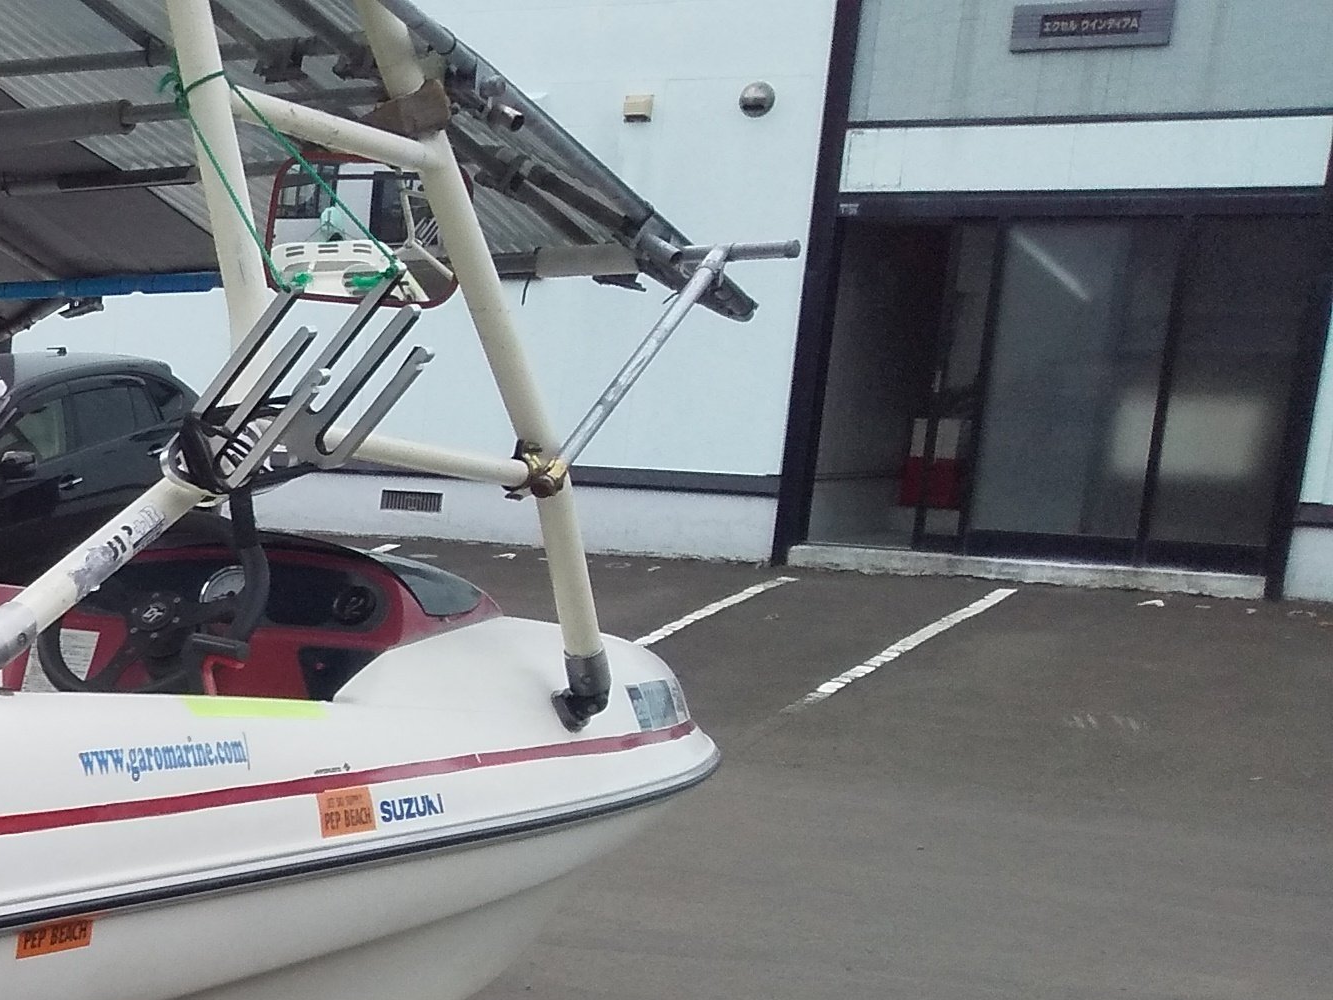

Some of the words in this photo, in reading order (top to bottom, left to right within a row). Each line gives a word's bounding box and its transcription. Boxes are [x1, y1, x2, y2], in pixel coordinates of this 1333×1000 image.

[1043, 20, 1077, 32] エクセル
[78, 736, 247, 782] www.garomarine.com
[323, 811, 341, 831] PEP
[344, 807, 372, 828] BEACH
[380, 793, 445, 823] SUZUKI
[23, 929, 47, 950] PEP
[49, 920, 88, 946] BEACH
